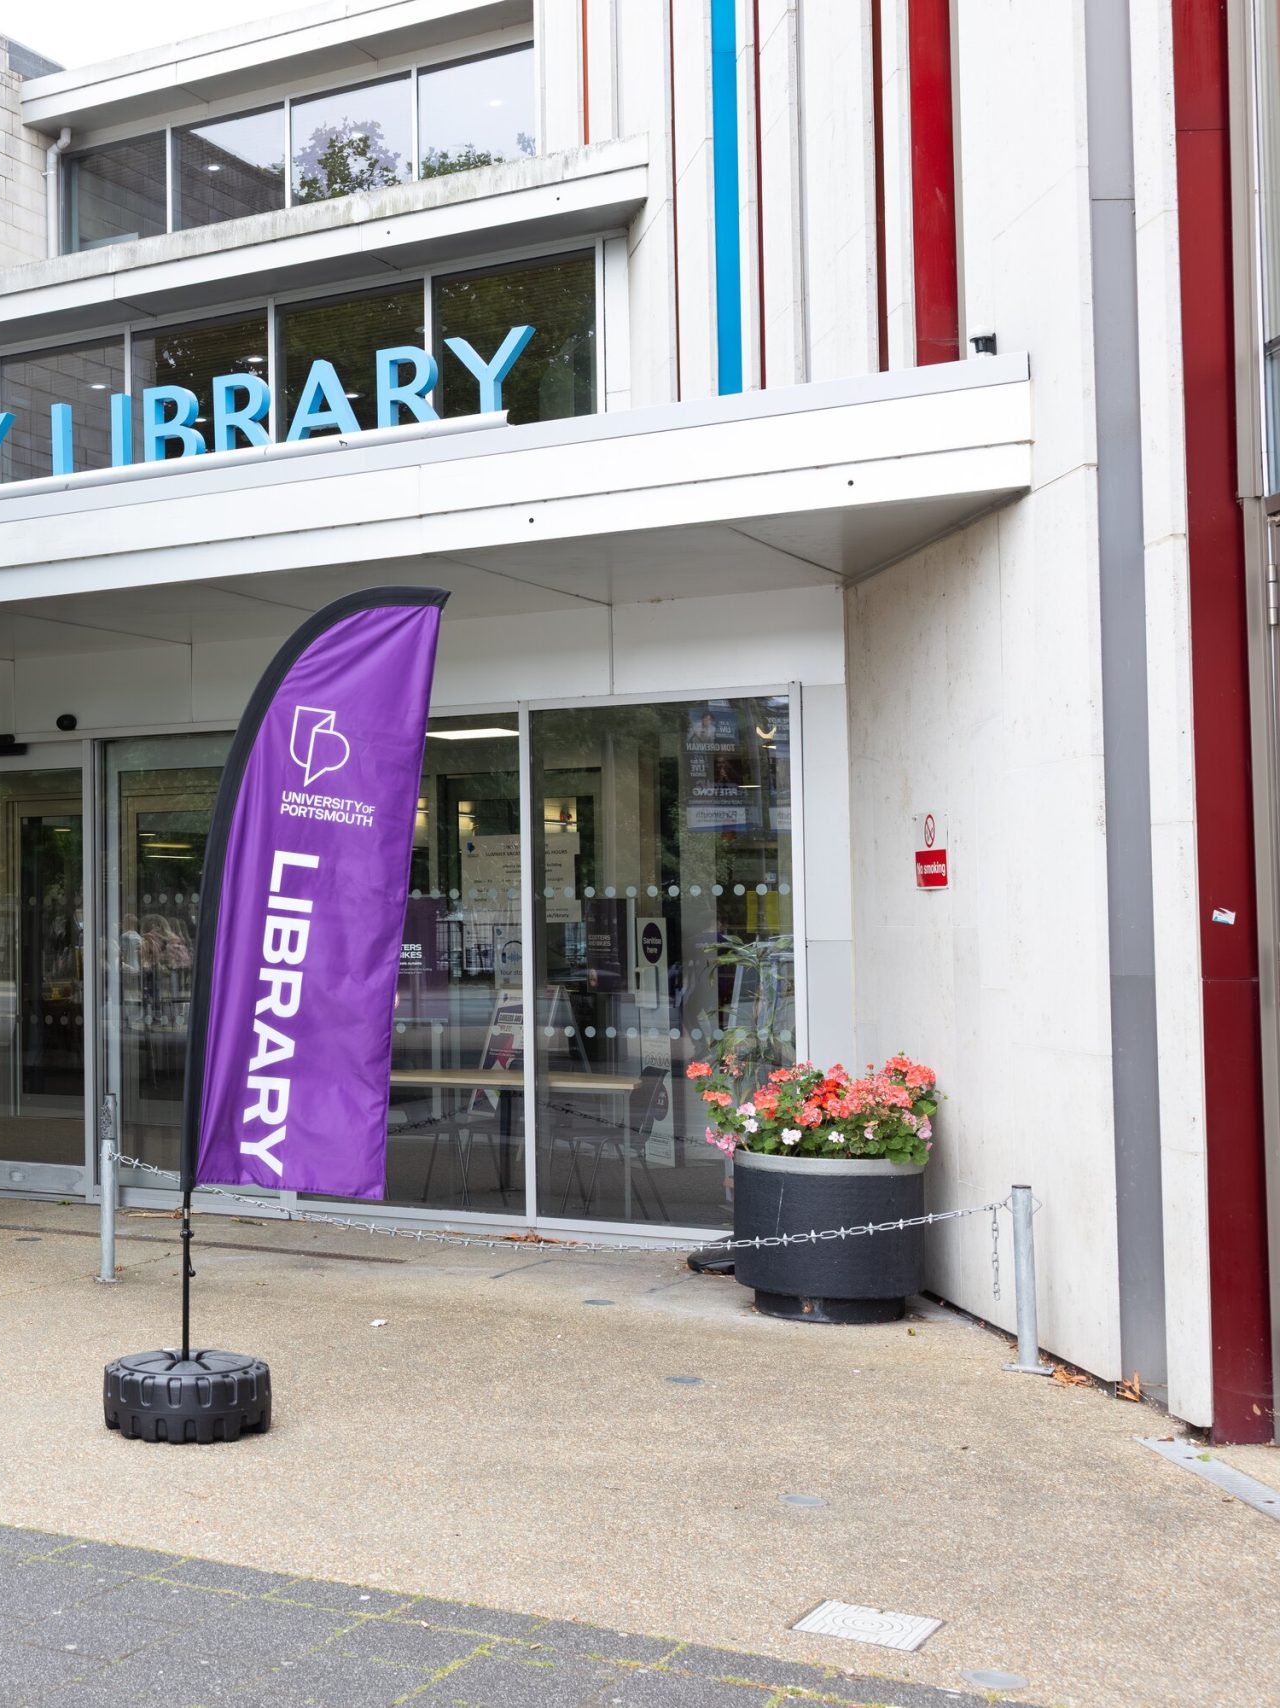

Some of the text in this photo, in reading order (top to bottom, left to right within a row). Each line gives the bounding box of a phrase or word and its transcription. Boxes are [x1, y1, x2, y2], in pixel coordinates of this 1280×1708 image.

[51, 324, 536, 476] LIBRARY
[282, 791, 376, 814] UNIVERSITY OF
[280, 803, 373, 827] PORTSMOUTH
[917, 861, 946, 877] No smoking
[239, 849, 320, 1178] LIBRARY
